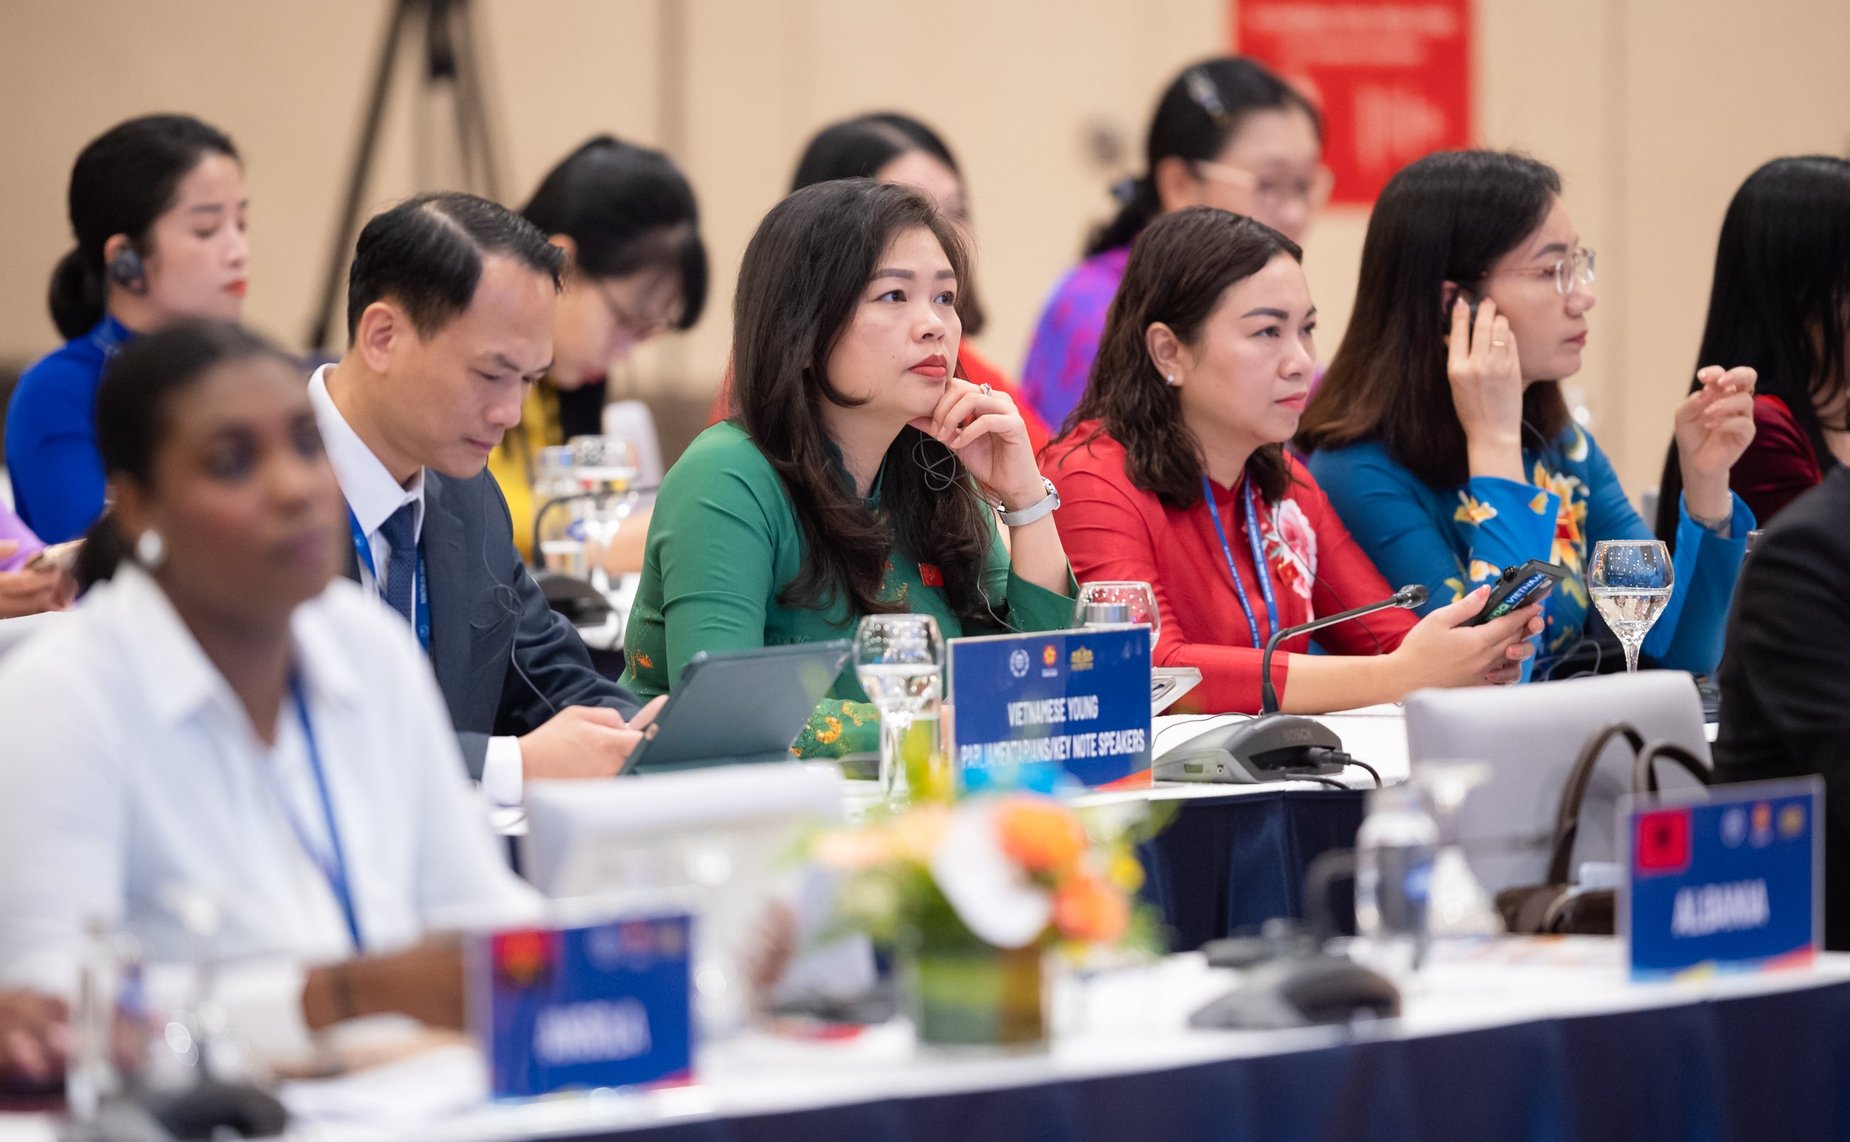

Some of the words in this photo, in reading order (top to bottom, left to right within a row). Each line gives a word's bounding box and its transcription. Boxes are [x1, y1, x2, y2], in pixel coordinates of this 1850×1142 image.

[1007, 697, 1067, 727] VIETNAMESE
[1067, 694, 1099, 721] YOUNG
[1072, 732, 1098, 759] NOTE
[1098, 728, 1146, 757] SPEAKERS
